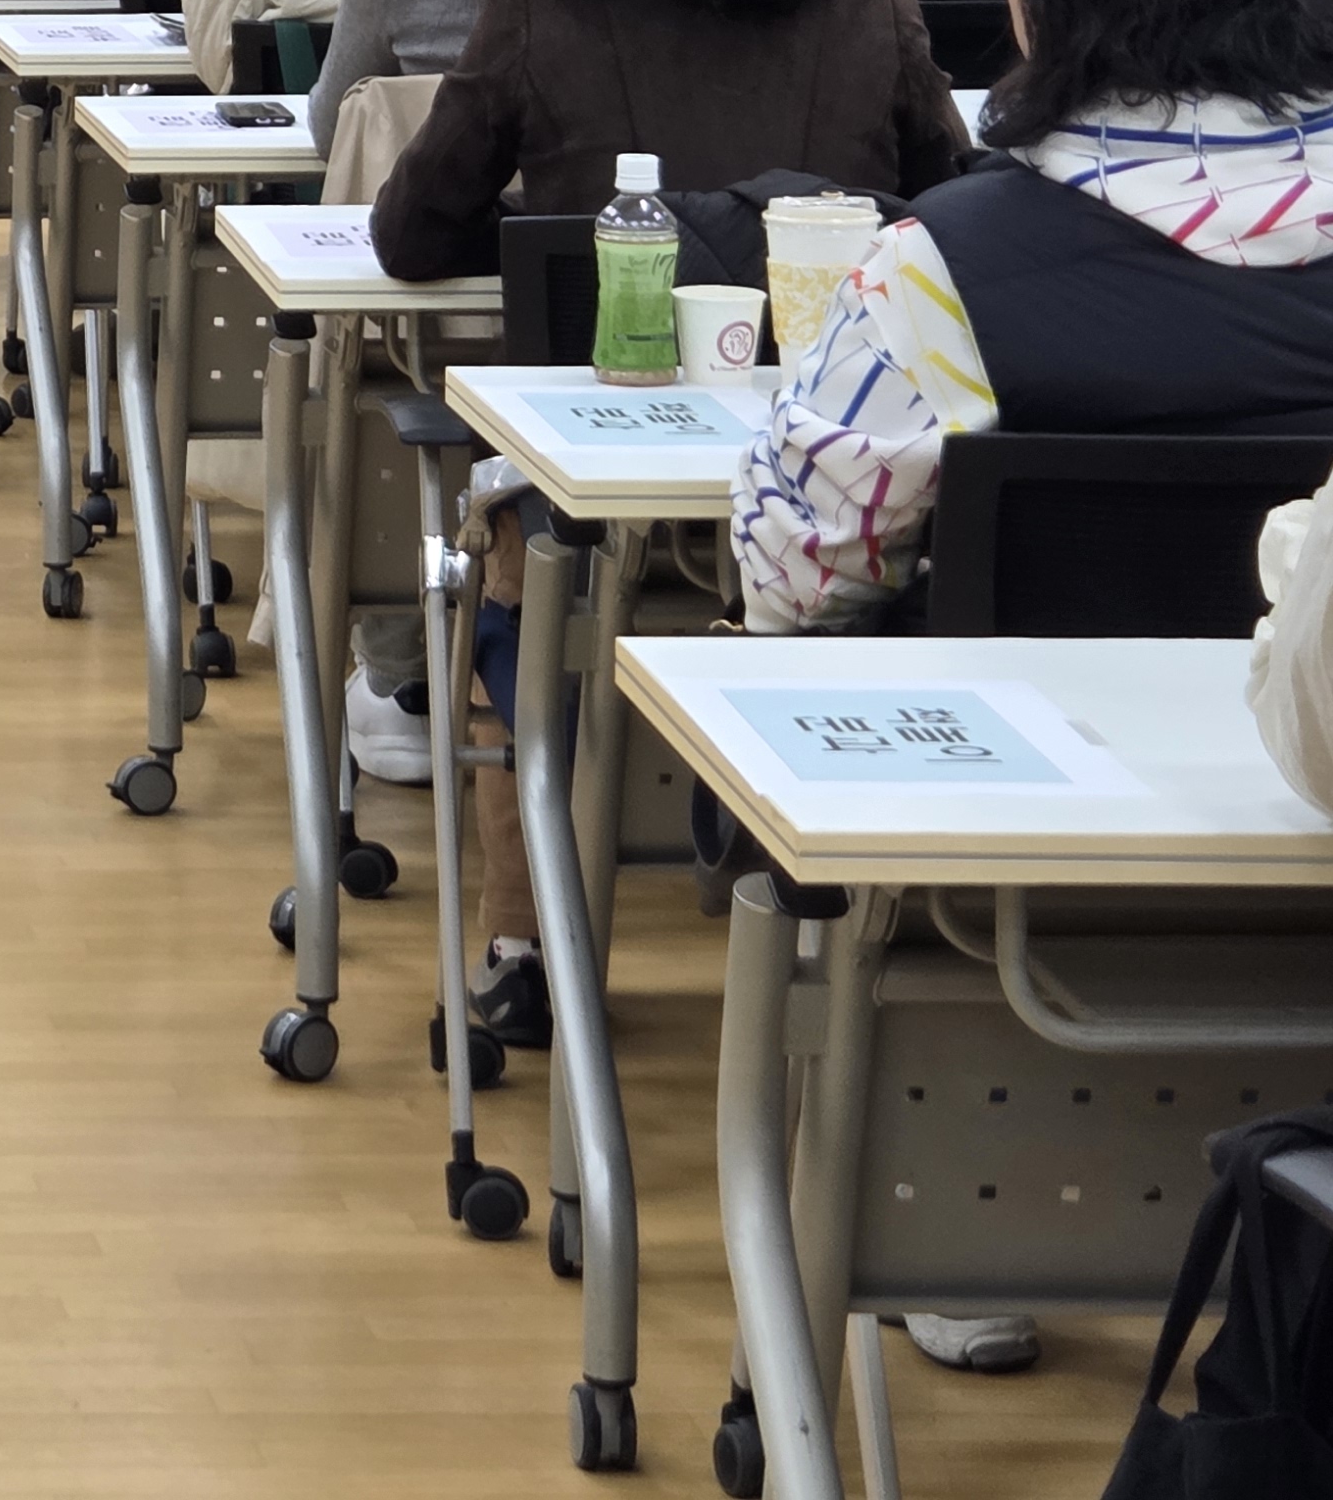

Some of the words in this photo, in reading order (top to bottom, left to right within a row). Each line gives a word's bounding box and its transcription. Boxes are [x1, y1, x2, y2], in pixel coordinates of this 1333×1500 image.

[570, 407, 646, 430] 분과
[792, 714, 900, 754] 분과
[885, 707, 1004, 764] 책놀이
